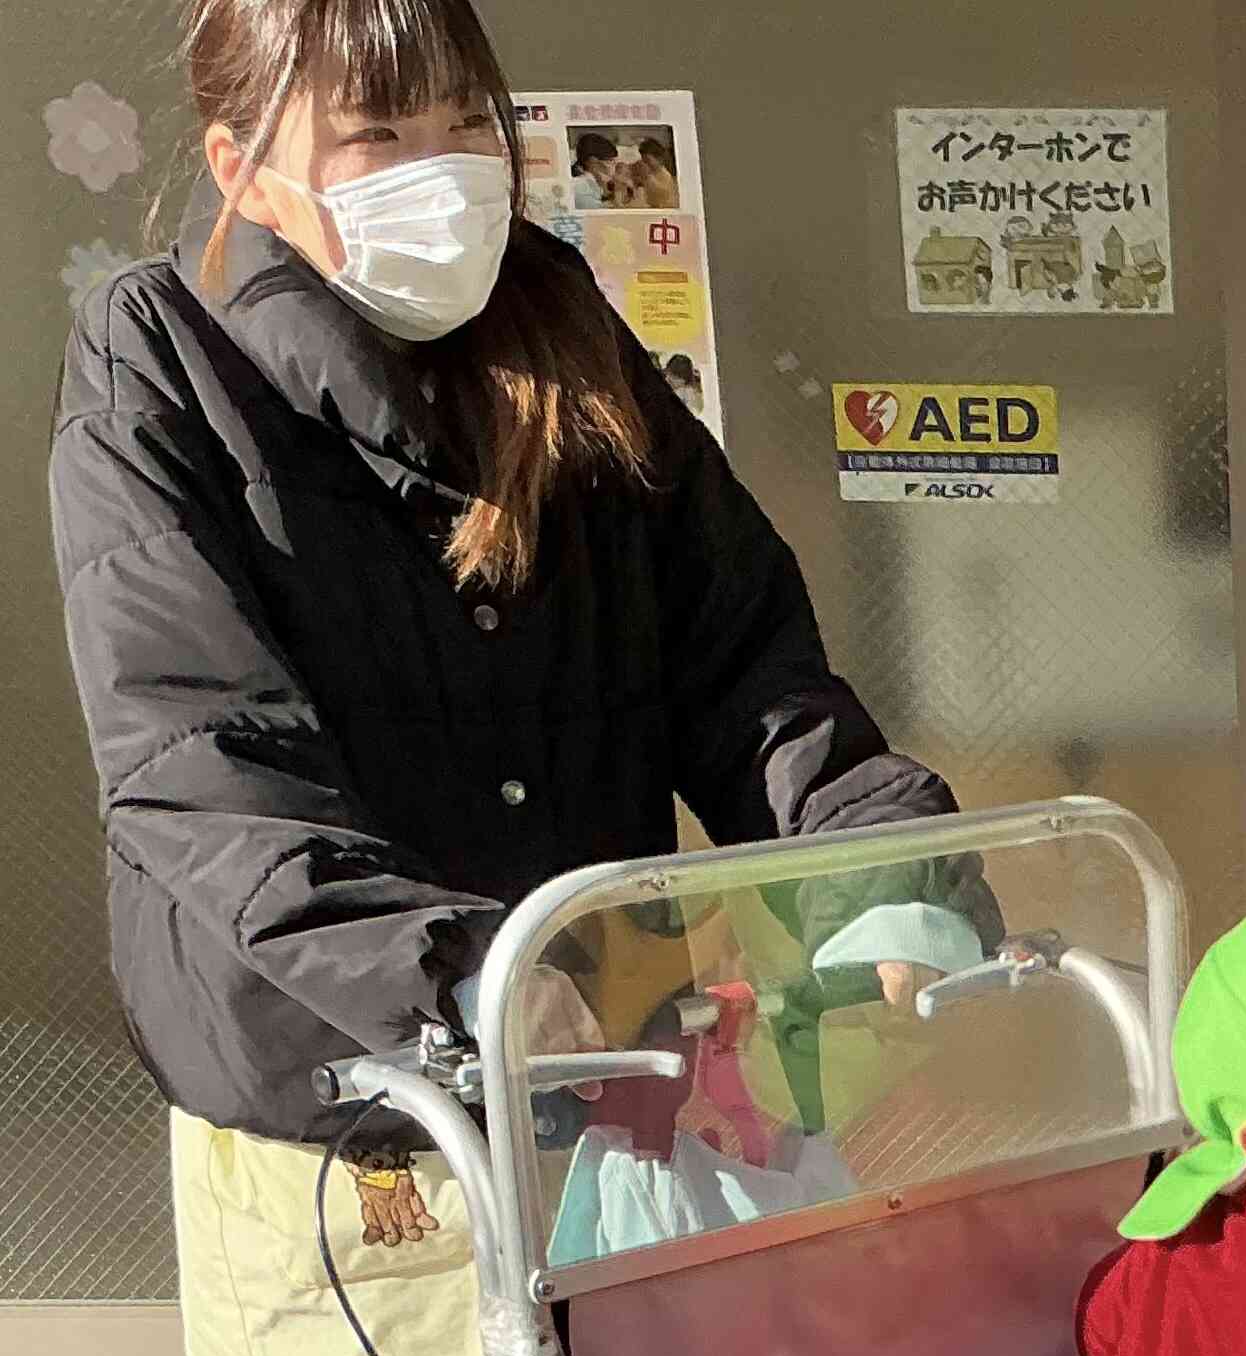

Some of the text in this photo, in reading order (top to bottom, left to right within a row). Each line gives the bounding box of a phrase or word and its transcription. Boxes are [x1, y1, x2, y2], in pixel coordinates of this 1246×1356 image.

[931, 130, 1133, 164] インターホンで
[916, 180, 1152, 214] お声かけください
[908, 396, 1040, 444] AED
